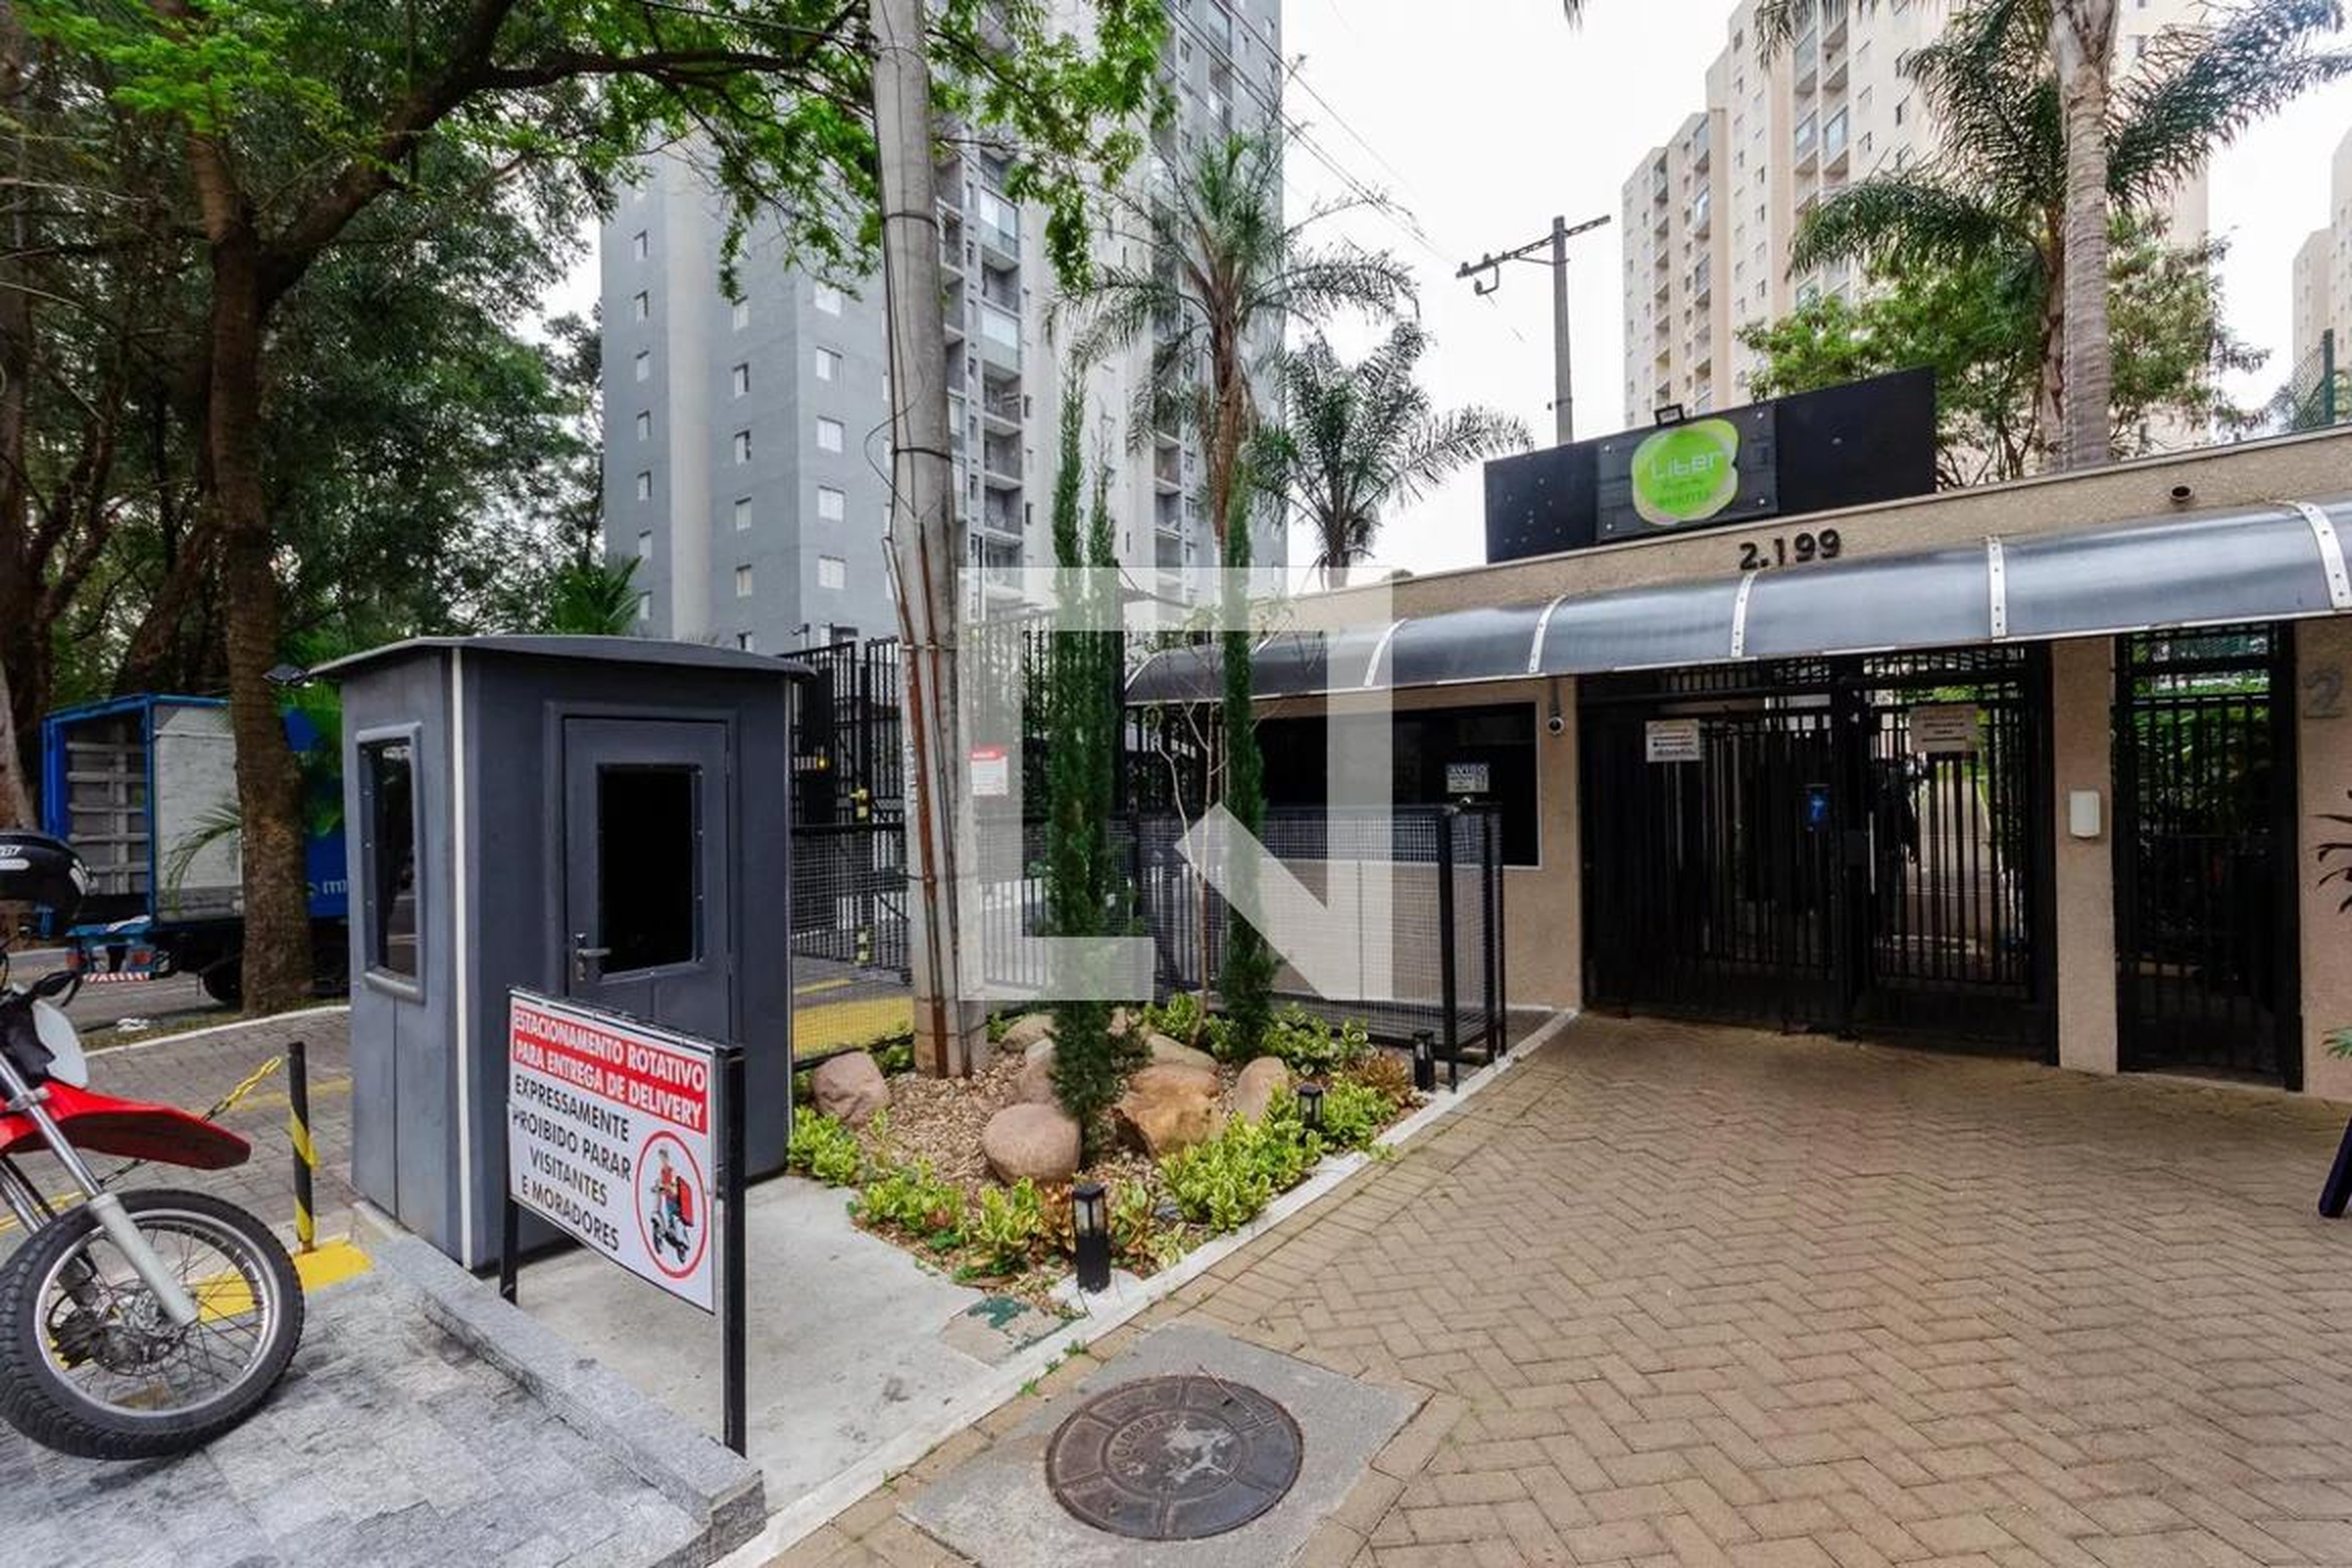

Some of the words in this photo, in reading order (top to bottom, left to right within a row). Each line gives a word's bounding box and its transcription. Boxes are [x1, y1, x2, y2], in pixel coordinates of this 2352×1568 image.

[1740, 528, 1841, 571] 2.199
[515, 1010, 624, 1065] ESTACIONAMENTO
[627, 1042, 706, 1093] ROTATIVO
[515, 1039, 545, 1069] PARA
[546, 1051, 605, 1093] ENTREGA
[606, 1072, 626, 1100] DE
[628, 1080, 703, 1128] DELIVERY
[515, 1074, 629, 1142] EXPRESSAMENTE
[513, 1109, 578, 1154] PROIBIDO
[582, 1139, 631, 1182] PARAR
[529, 1145, 608, 1207] VISITANTES
[522, 1175, 528, 1195] E
[532, 1181, 619, 1252] MORADORES
